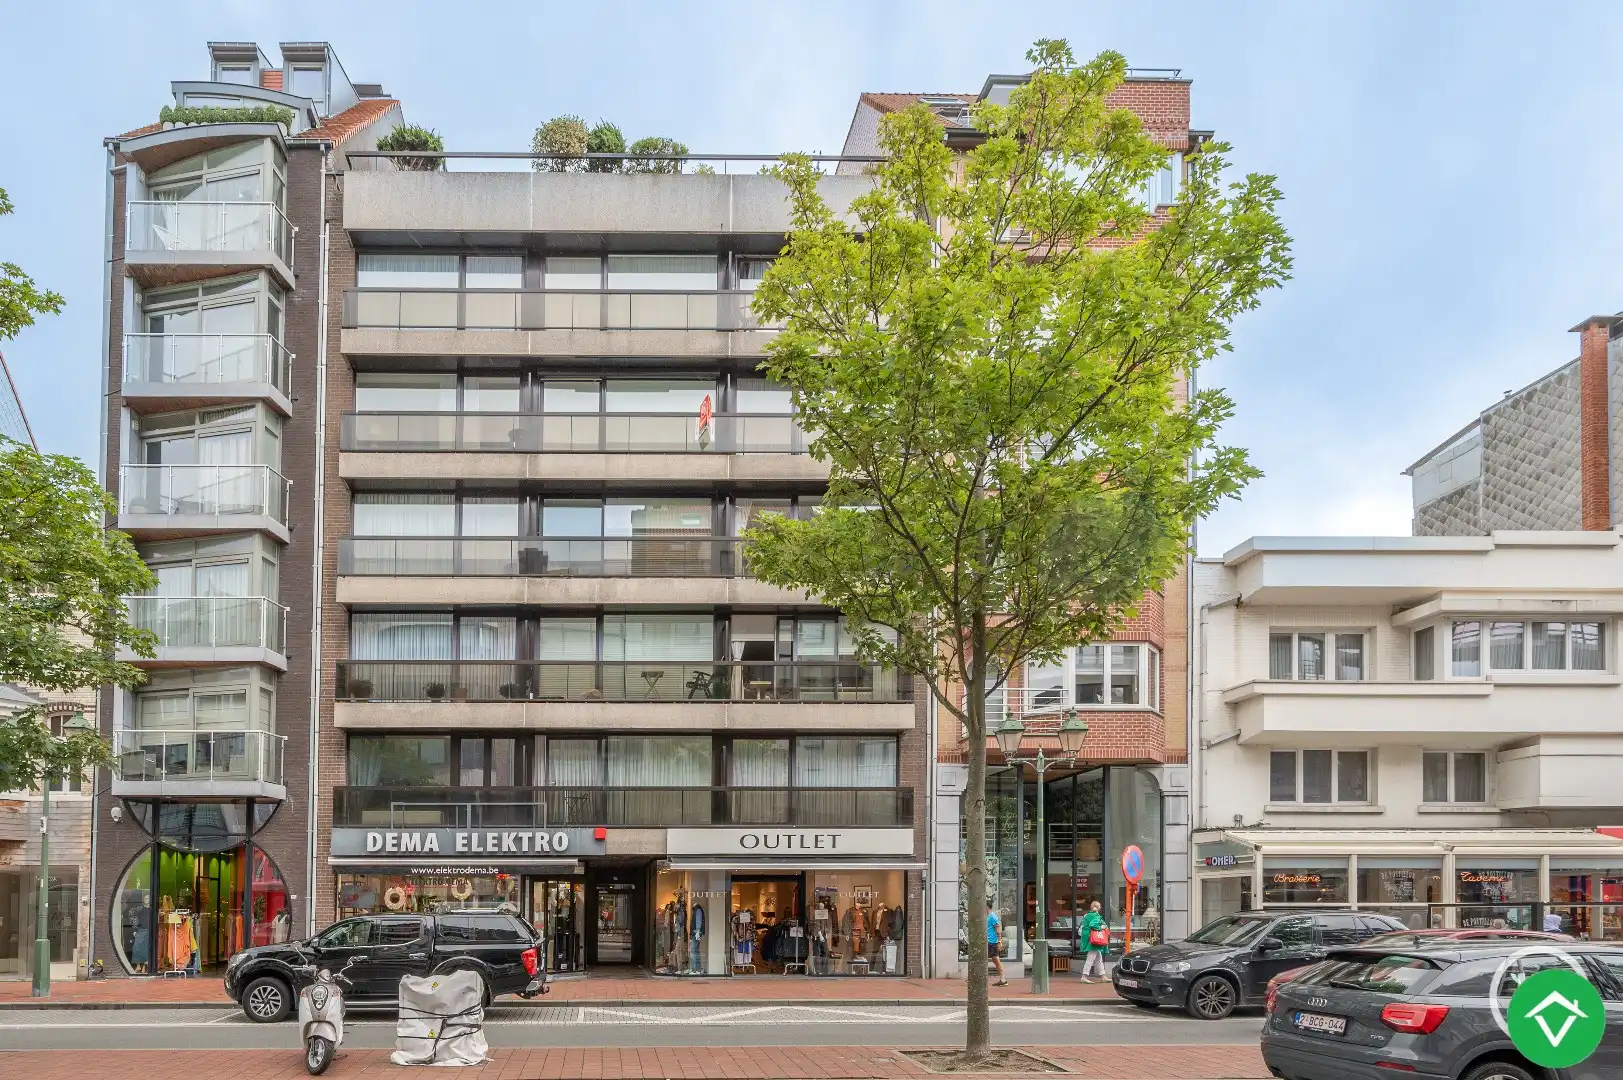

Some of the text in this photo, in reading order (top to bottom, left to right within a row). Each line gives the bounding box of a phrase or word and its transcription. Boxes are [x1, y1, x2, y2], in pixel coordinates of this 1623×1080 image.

[366, 831, 569, 852] DEMA ELEKTRO
[739, 833, 842, 849] OUTLET
[410, 866, 499, 875] www.elektrodema.be
[1273, 873, 1321, 883] Brasserie
[687, 891, 728, 899] OUTLET
[839, 891, 880, 899] OUTLET
[1300, 1014, 1344, 1031] 2-BCG-044
